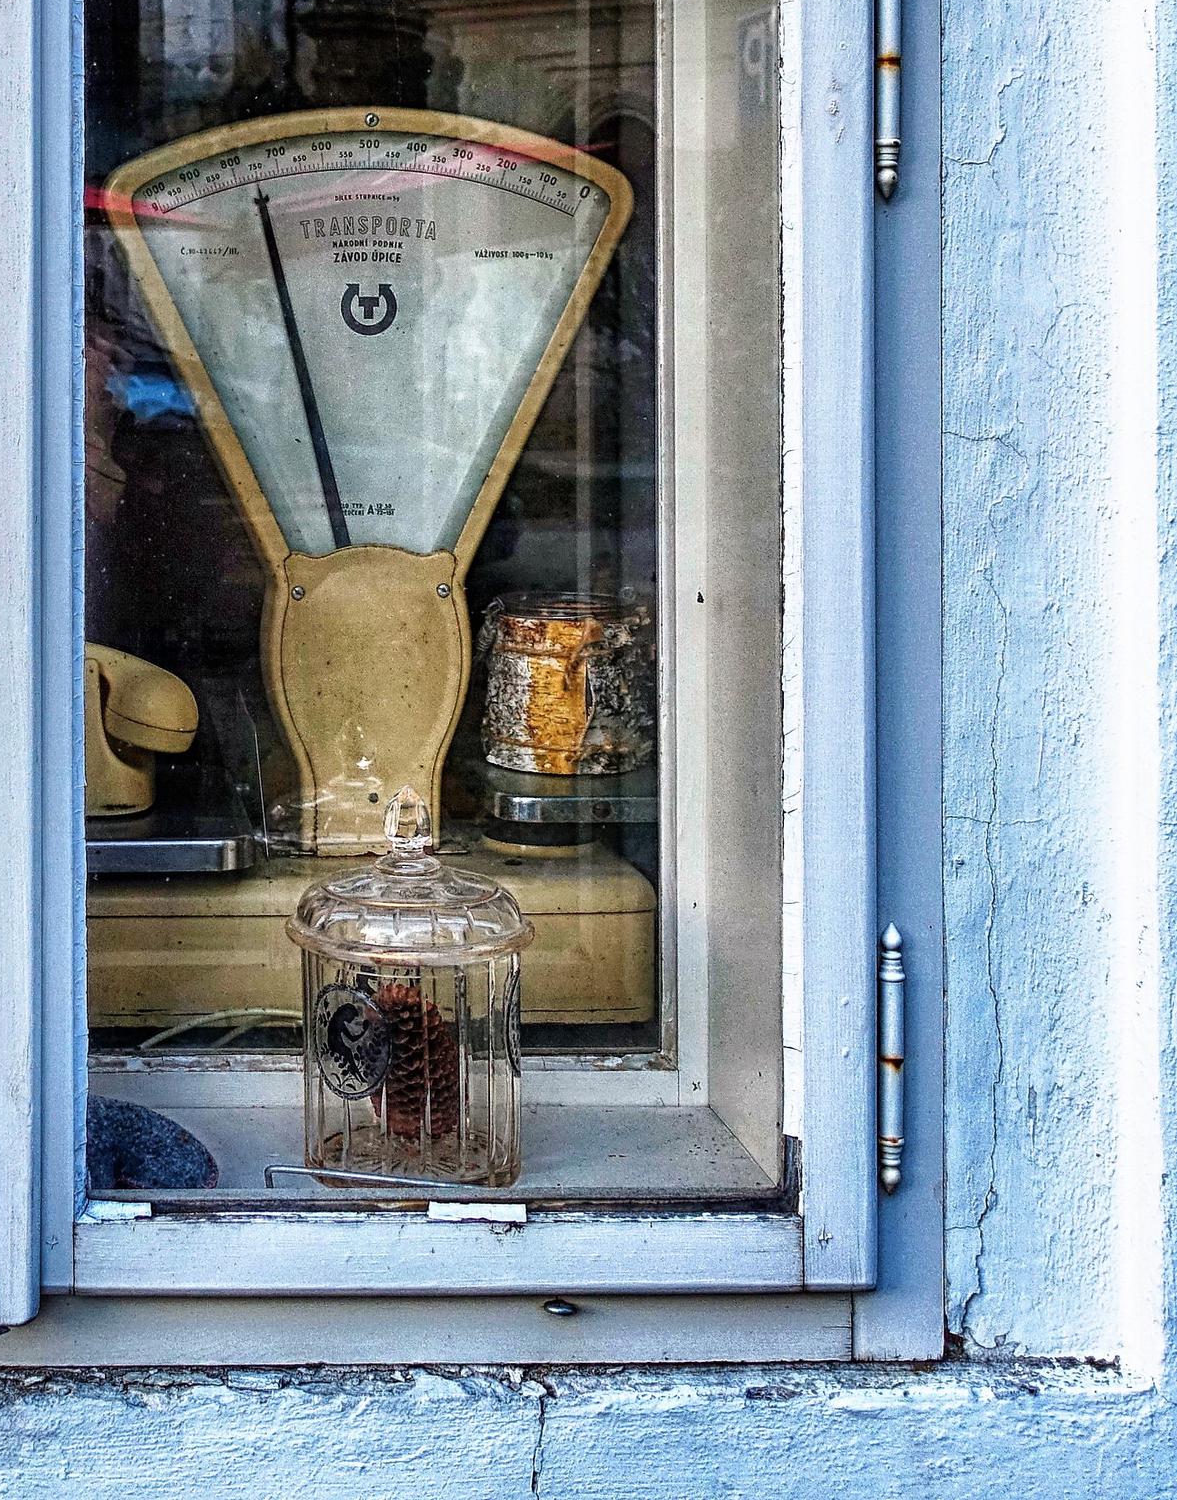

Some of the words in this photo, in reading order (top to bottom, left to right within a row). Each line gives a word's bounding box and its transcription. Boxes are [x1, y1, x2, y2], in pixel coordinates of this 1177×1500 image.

[167, 187, 182, 197] 950
[205, 173, 221, 183] 850
[248, 162, 263, 171] 750
[292, 155, 307, 163] 650
[338, 151, 353, 159] 550
[385, 151, 401, 159] 450
[432, 155, 447, 164] 350
[475, 163, 491, 173] 250
[518, 175, 532, 185] 150
[556, 190, 567, 199] 50
[179, 168, 200, 182] 900
[220, 156, 241, 169] 800
[265, 146, 285, 158] 700
[311, 141, 332, 151] 600
[359, 139, 380, 149] 500
[406, 142, 427, 153] 400
[452, 148, 474, 160] 300
[496, 158, 517, 171] 200
[539, 172, 558, 186] 100
[579, 185, 591, 199] 0
[299, 215, 437, 241] TRANSPORTA
[332, 238, 369, 248] NÁRODNÍ
[372, 239, 403, 249] PODNIK
[333, 250, 368, 263] ZÁVOD
[371, 250, 402, 263] ÚPICE
